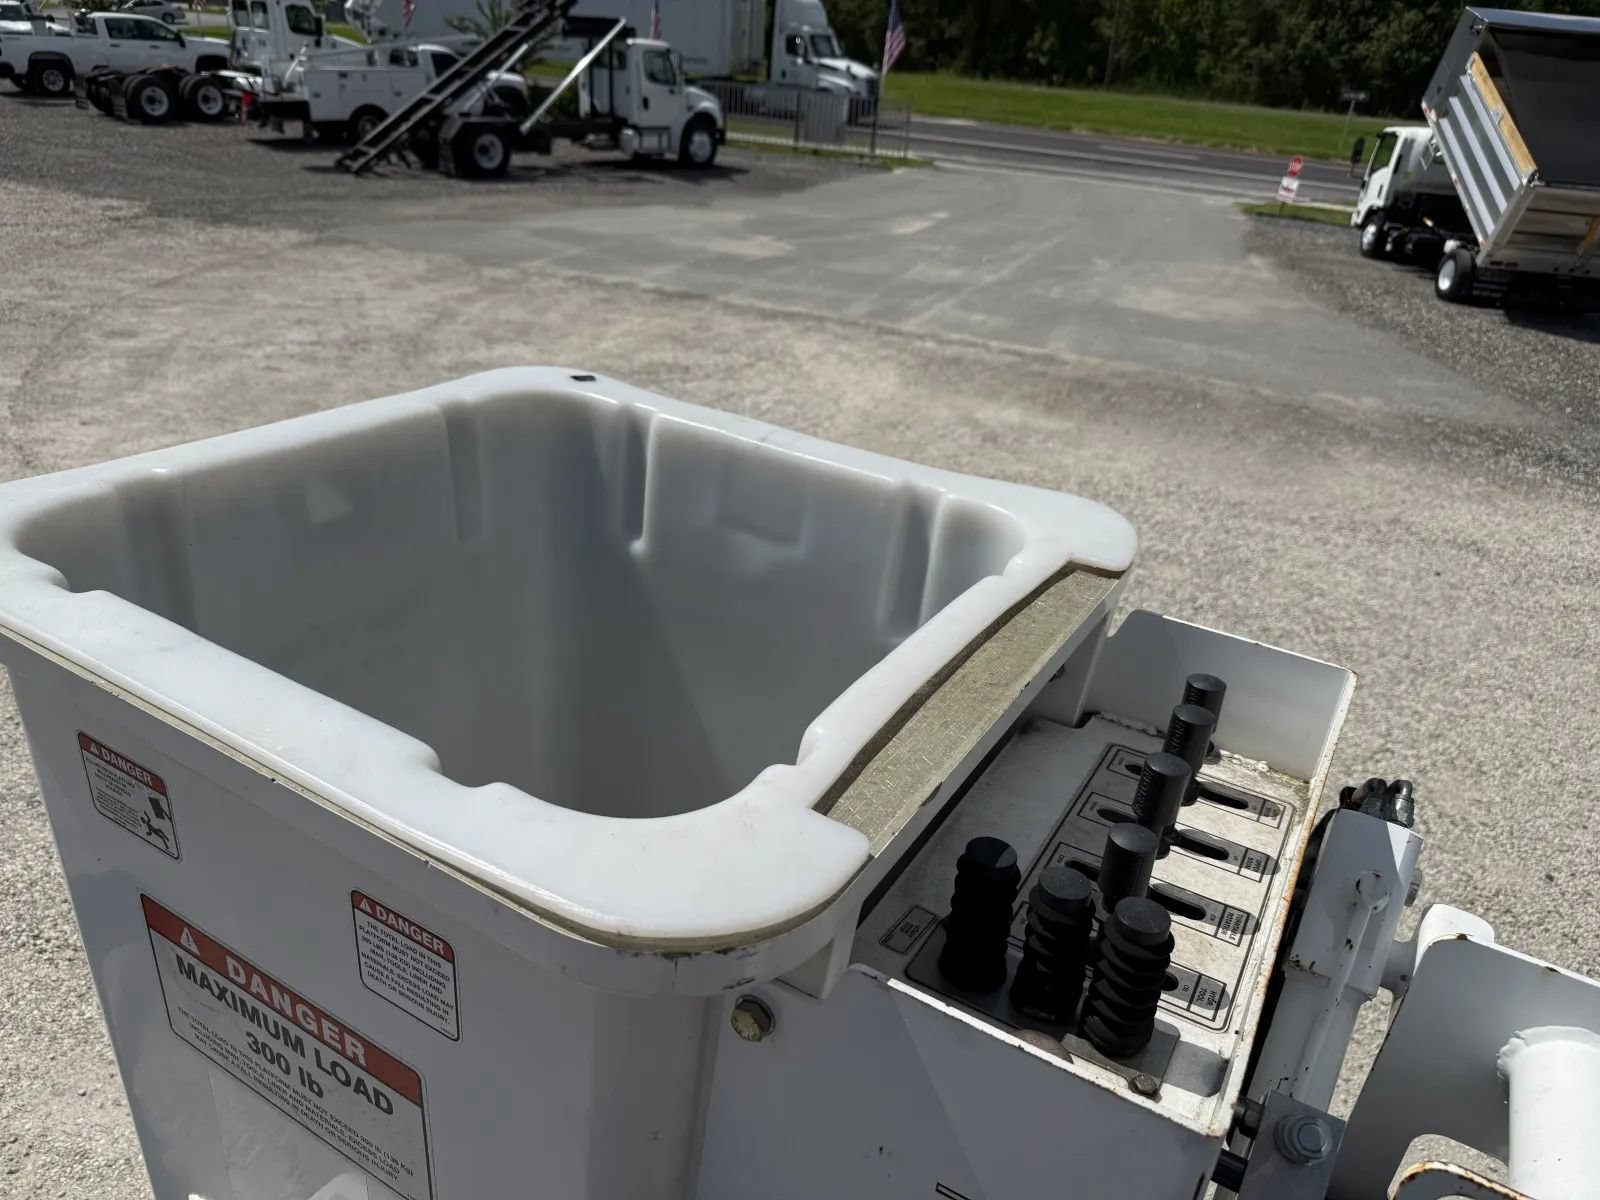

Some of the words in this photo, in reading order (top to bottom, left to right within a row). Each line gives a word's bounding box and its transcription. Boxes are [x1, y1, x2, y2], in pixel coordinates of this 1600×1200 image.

[101, 749, 153, 786] DANGER
[367, 921, 378, 932] THE
[381, 929, 398, 944] TOTAL
[401, 941, 417, 955] LOAD
[419, 952, 425, 960] IN
[427, 956, 441, 969] THIS
[375, 905, 444, 955] DANGER
[359, 925, 391, 948] PLATFORM
[393, 944, 409, 959] MUST
[411, 955, 423, 967] NOT
[425, 964, 450, 983] EXCEED
[365, 962, 384, 977] CAUSE
[391, 978, 406, 990] FALL
[407, 987, 441, 1011] RESULTING
[443, 1008, 449, 1016] IN
[368, 972, 387, 986] DEATH
[388, 984, 397, 993] OR
[397, 973, 420, 991] EXCESS
[423, 988, 439, 1002] LOAD
[441, 999, 454, 1011] MAY
[412, 965, 446, 989] INCLUDING
[430, 983, 442, 995] AND
[1196, 987, 1207, 1002] TOOL
[225, 955, 367, 1067] DANGER
[175, 953, 305, 1058] MAXIMUM
[314, 1048, 393, 1116] LOAD
[212, 1030, 229, 1047] LOAD
[239, 1049, 254, 1064] THIS
[245, 1031, 291, 1076] 300
[298, 1067, 324, 1099] lb
[289, 1093, 304, 1108] AND
[380, 1156, 400, 1175] LOAD
[300, 1109, 324, 1130] DEATH
